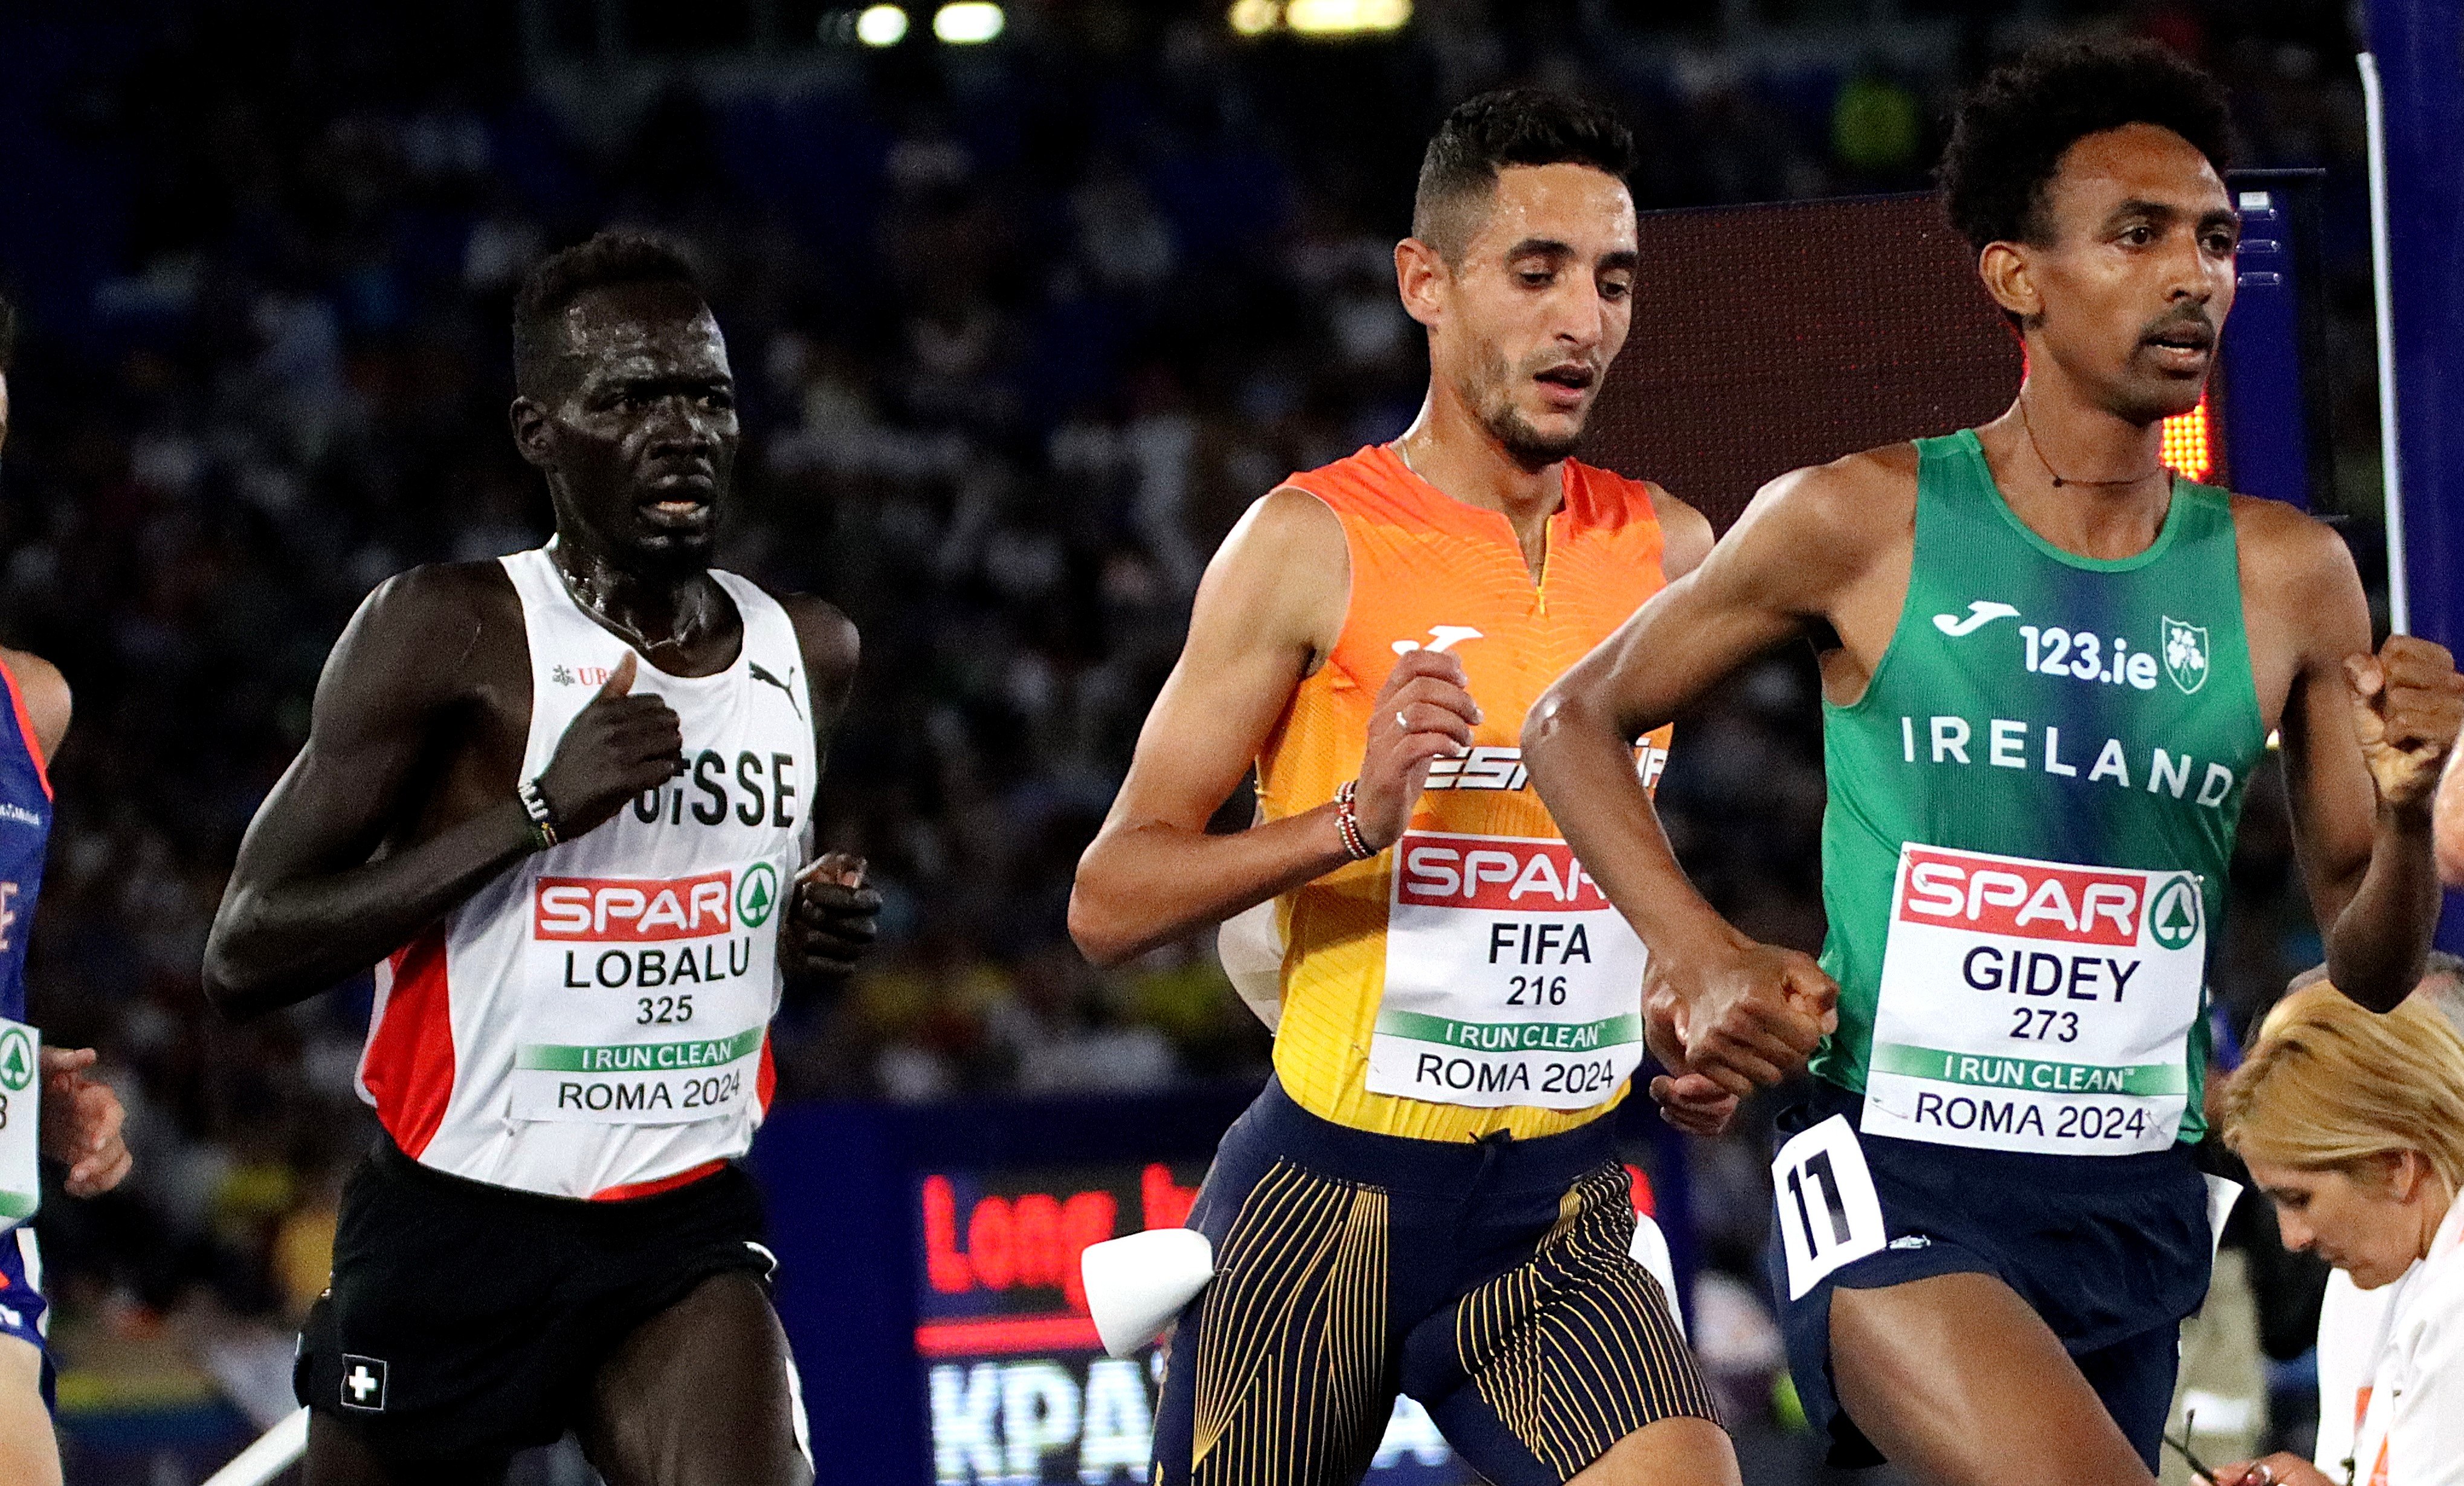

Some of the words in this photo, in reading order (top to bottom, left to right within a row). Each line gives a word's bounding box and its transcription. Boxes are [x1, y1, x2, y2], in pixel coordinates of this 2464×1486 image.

[2019, 625, 2158, 690] 123.ie
[1901, 716, 2233, 808] IRELAND
[540, 880, 727, 933] SPAR
[1908, 862, 2138, 937] SPAR
[563, 937, 750, 988] LOBALU
[1488, 922, 1592, 965] FIFA
[1506, 975, 1567, 1006] 216
[1962, 945, 2140, 1003] GIDEY
[636, 995, 693, 1025] 325
[2010, 1007, 2079, 1043] 273
[1445, 1022, 1453, 1042] I
[1460, 1025, 1519, 1048] RUN
[582, 1048, 589, 1068] I
[595, 1047, 651, 1069] RUN
[1416, 1053, 1529, 1093] ROMA
[1541, 1059, 1614, 1094] 2024
[1944, 1055, 1953, 1078] I
[1959, 1057, 2025, 1085] RUN
[558, 1082, 672, 1111] ROMA
[682, 1068, 740, 1108] 2024
[1915, 1092, 2045, 1137] ROMA
[2056, 1106, 2146, 1139] 2024
[1787, 1148, 1852, 1261] 11
